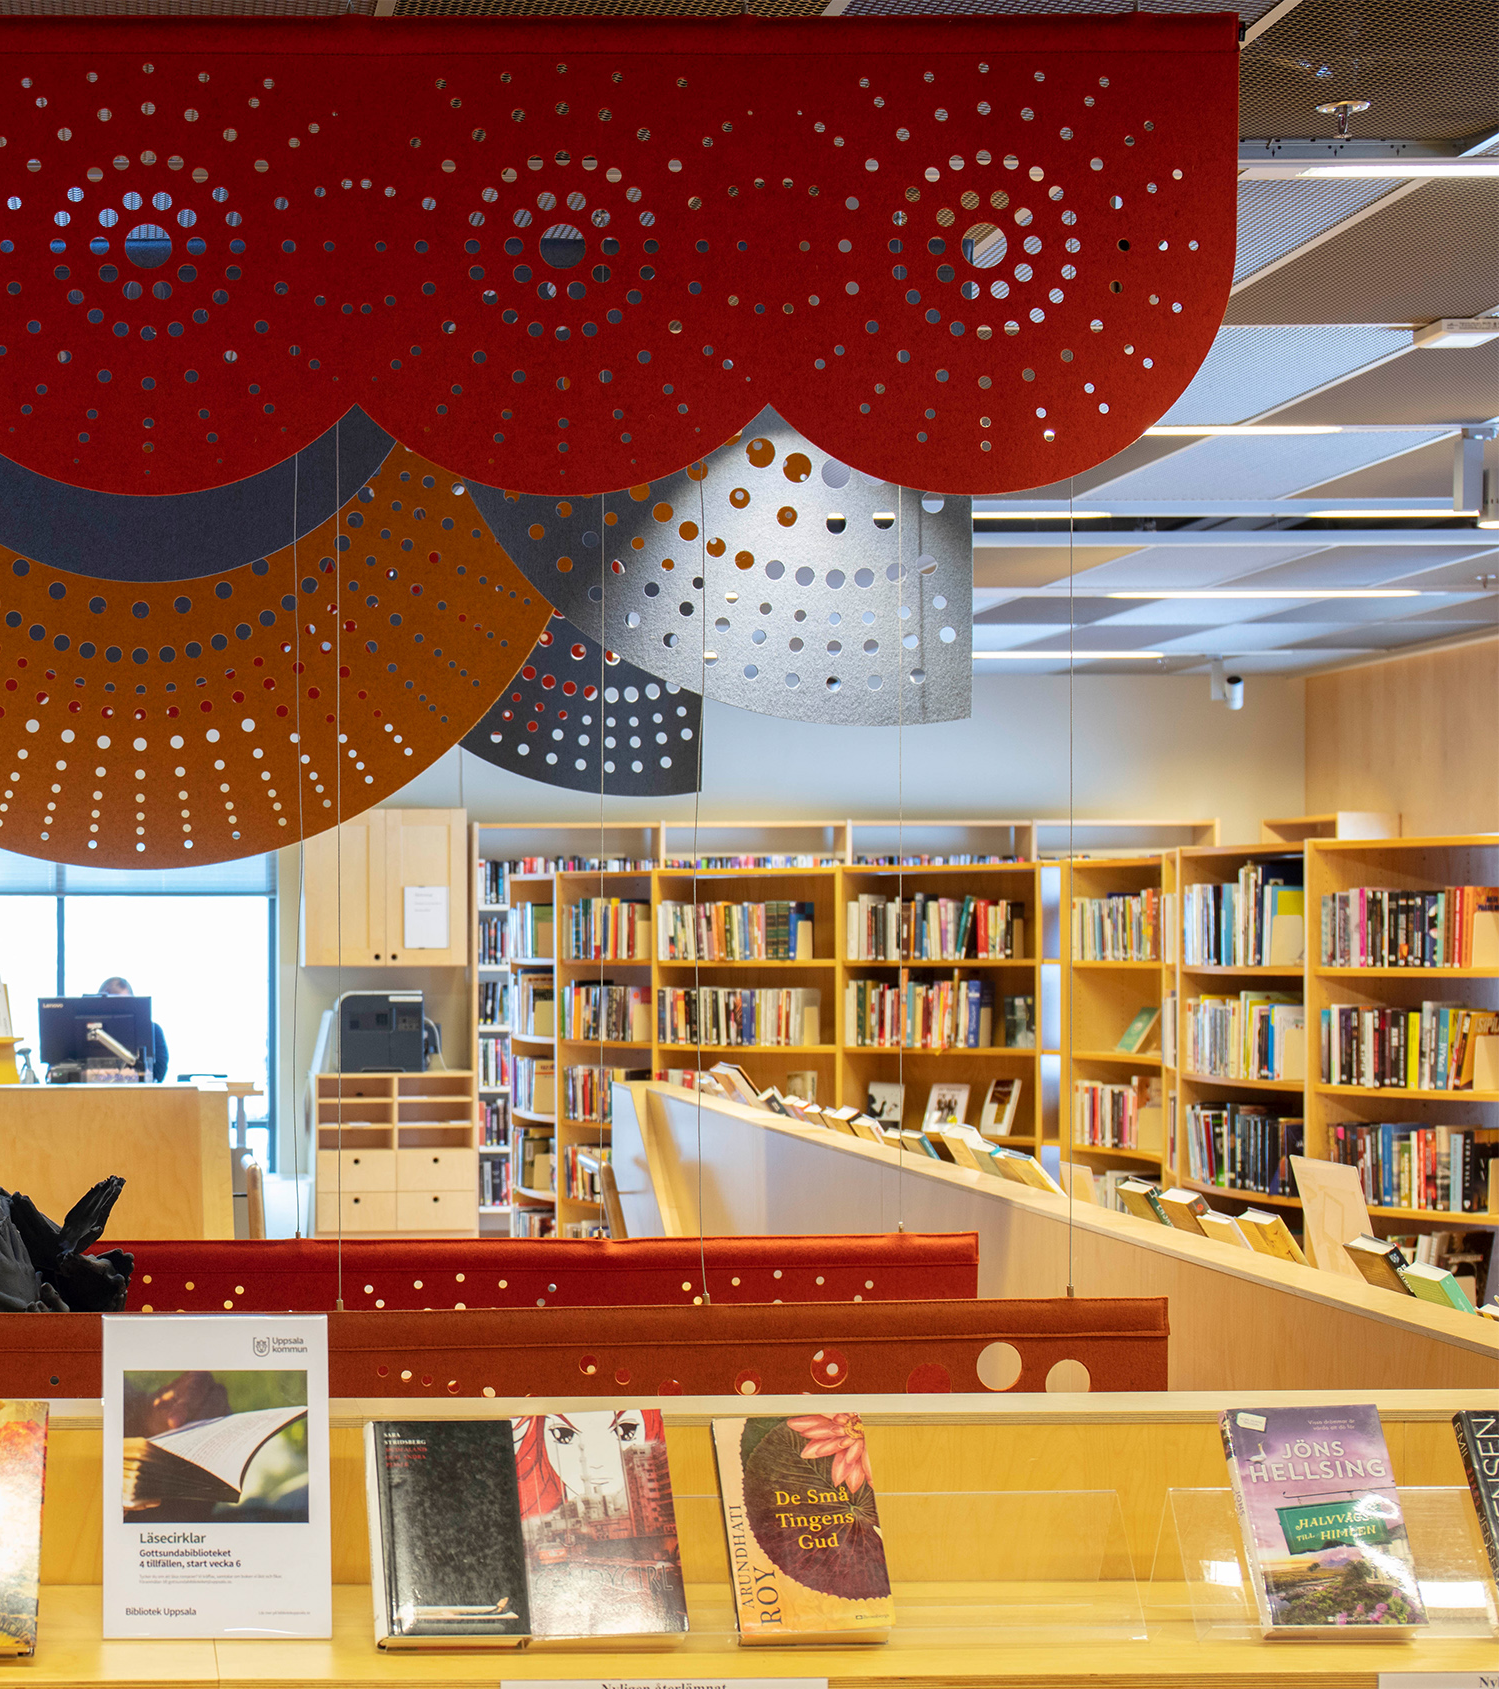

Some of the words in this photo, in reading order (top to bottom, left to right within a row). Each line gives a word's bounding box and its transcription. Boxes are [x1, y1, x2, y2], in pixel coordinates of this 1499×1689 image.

[272, 1337, 304, 1346] Uppsala
[1282, 1439, 1345, 1459] JÖNS
[1454, 1421, 1469, 1461] EMIL
[1249, 1459, 1387, 1483] HELLSING
[775, 1491, 801, 1506] De
[807, 1487, 850, 1504] Små
[776, 1513, 855, 1532] Tingens
[140, 1532, 207, 1544] Läsecirklar
[799, 1533, 840, 1550] Gud
[1296, 1533, 1316, 1542] TILL
[1320, 1525, 1377, 1541] HIMLEN
[139, 1548, 232, 1557] Gottsundabiblioteket
[729, 1504, 755, 1609] ARUNDHATI
[139, 1560, 145, 1568] 4
[146, 1559, 185, 1569] tillfällen,
[186, 1560, 208, 1568] start
[209, 1559, 234, 1568] vecka
[235, 1560, 242, 1568] 6
[753, 1566, 783, 1626] ROY
[125, 1607, 162, 1616] Bibliotek
[163, 1607, 197, 1617] Uppsala
